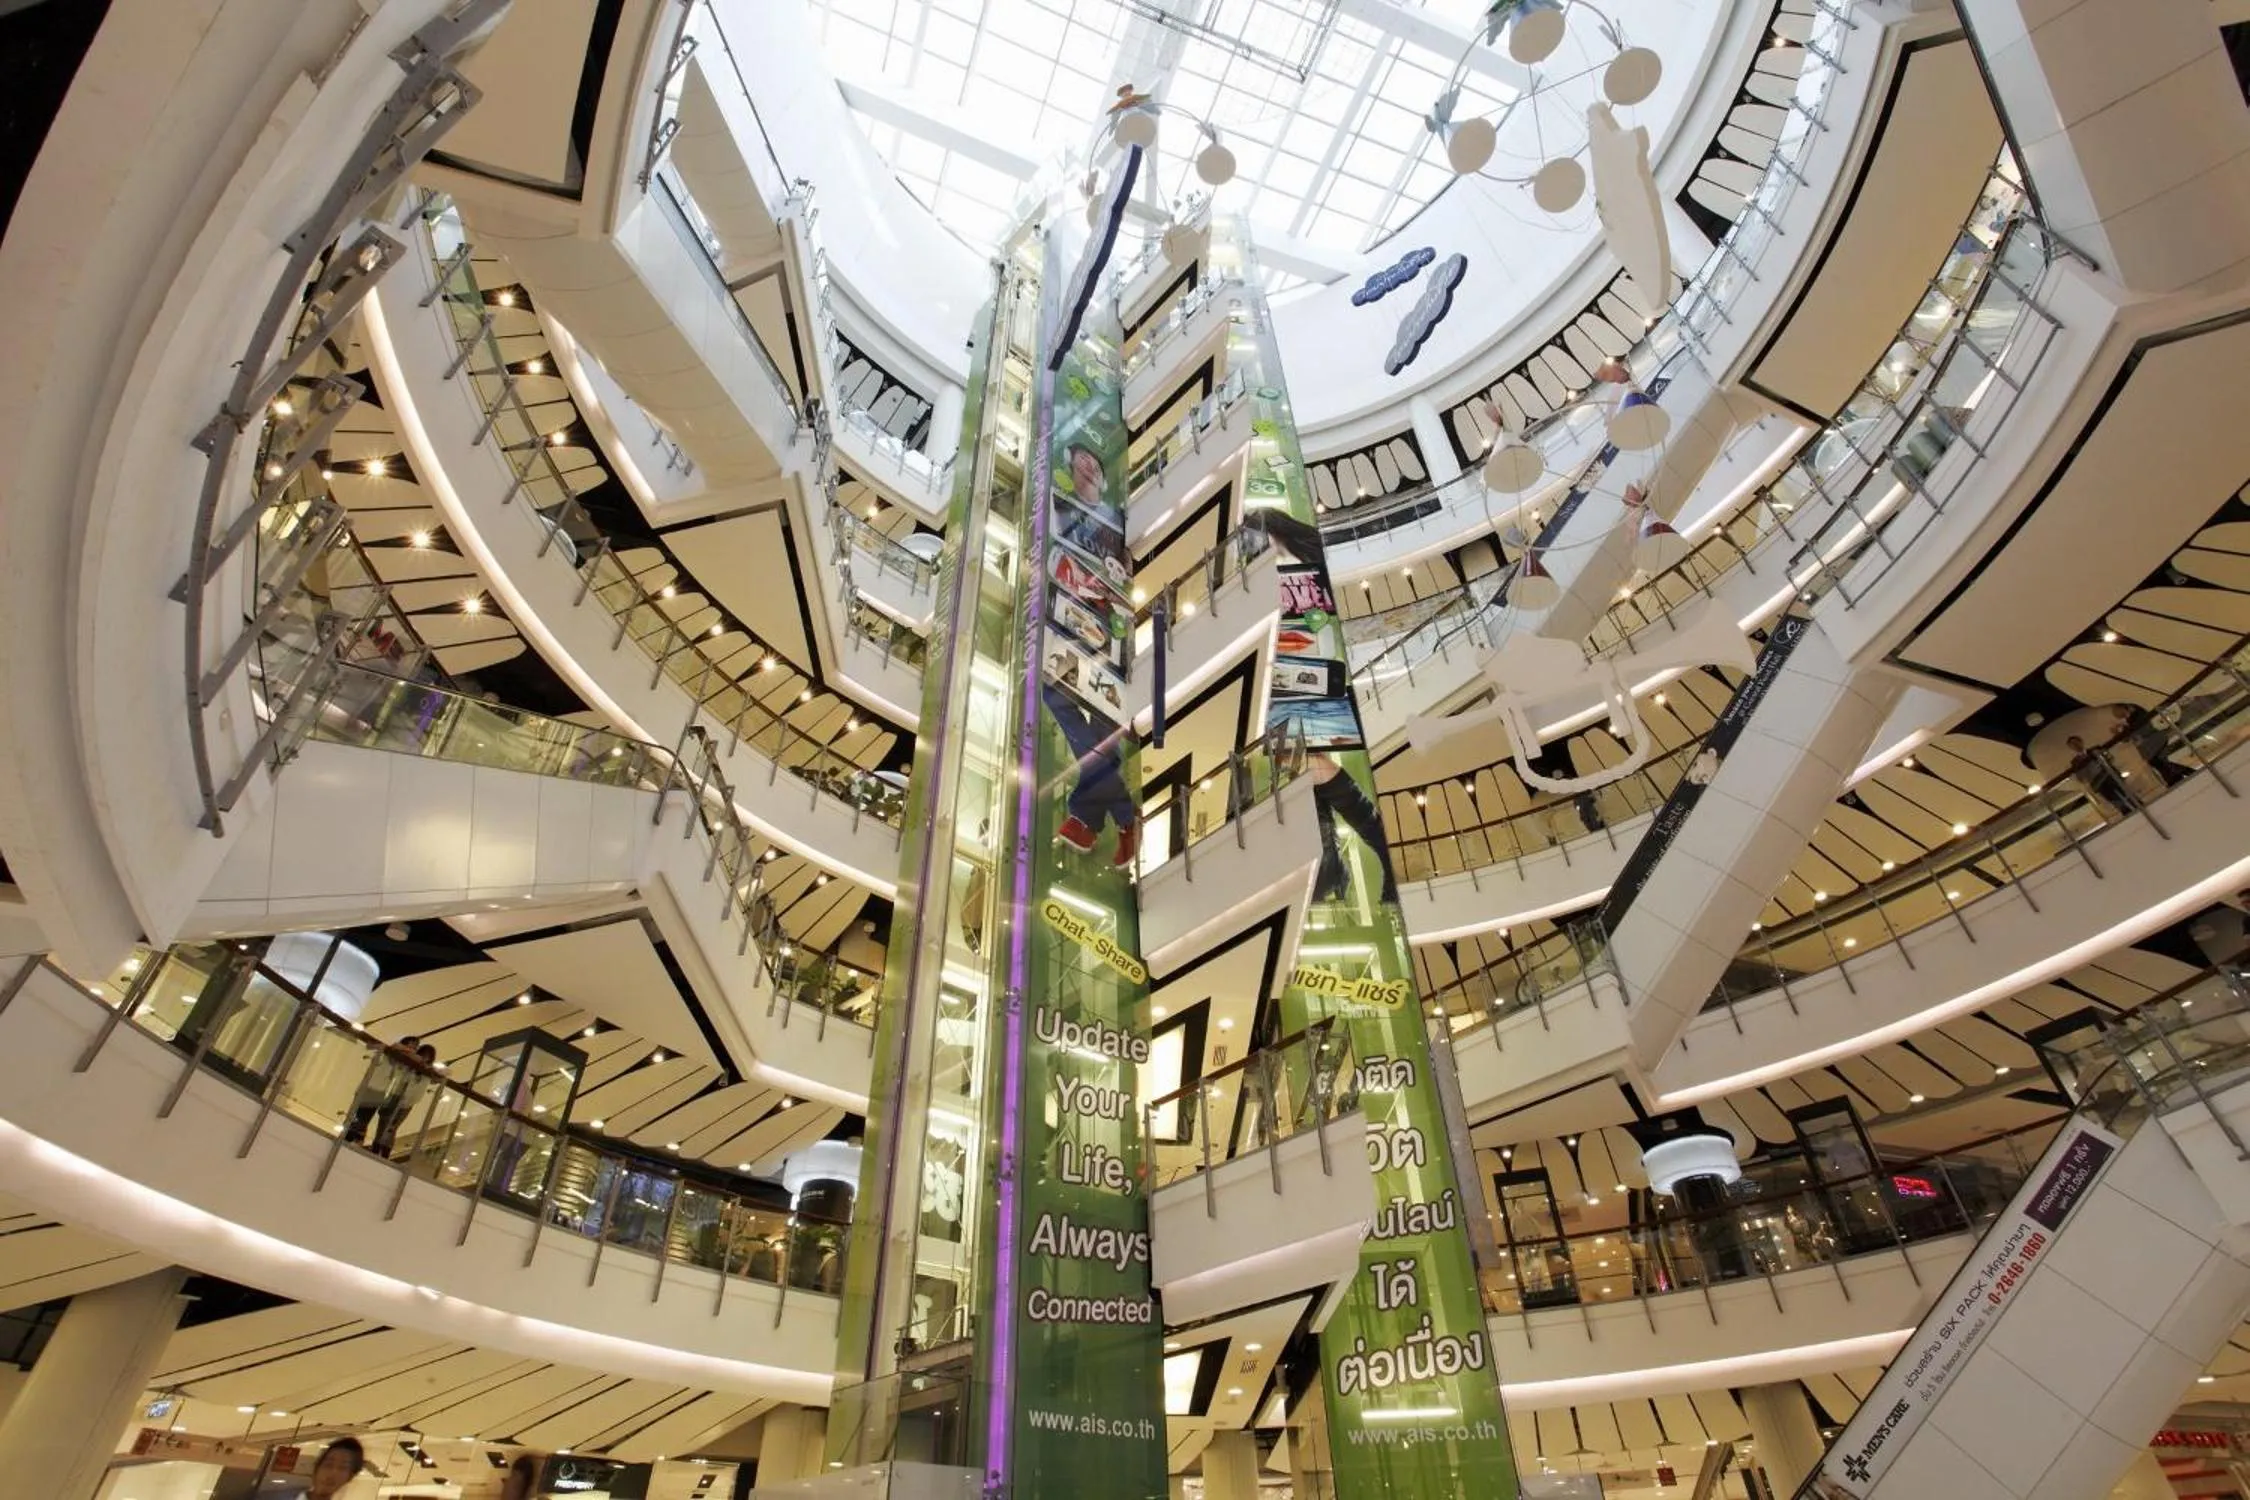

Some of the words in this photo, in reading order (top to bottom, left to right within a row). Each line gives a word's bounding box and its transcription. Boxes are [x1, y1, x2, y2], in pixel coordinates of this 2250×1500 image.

[1045, 903, 1086, 940] Chat
[1095, 937, 1142, 979] Share
[1356, 980, 1404, 1005] แชร์
[1035, 1005, 1149, 1063] Update
[1055, 1073, 1131, 1120] Your
[1062, 1142, 1134, 1196] Life,
[1029, 1213, 1149, 1272] Always
[1028, 1289, 1153, 1324] Connected
[1369, 1259, 1418, 1311] ได้
[1940, 1316, 1961, 1341] SIX
[1956, 1279, 1987, 1317] PACK
[1338, 1315, 1485, 1396] ต่อเนื่อง
[1028, 1409, 1156, 1441] www.ais.co.th
[1347, 1420, 1498, 1446] www.ais.co.th
[1861, 1424, 1890, 1460] MEN'S
[1885, 1399, 1911, 1428] CARE
